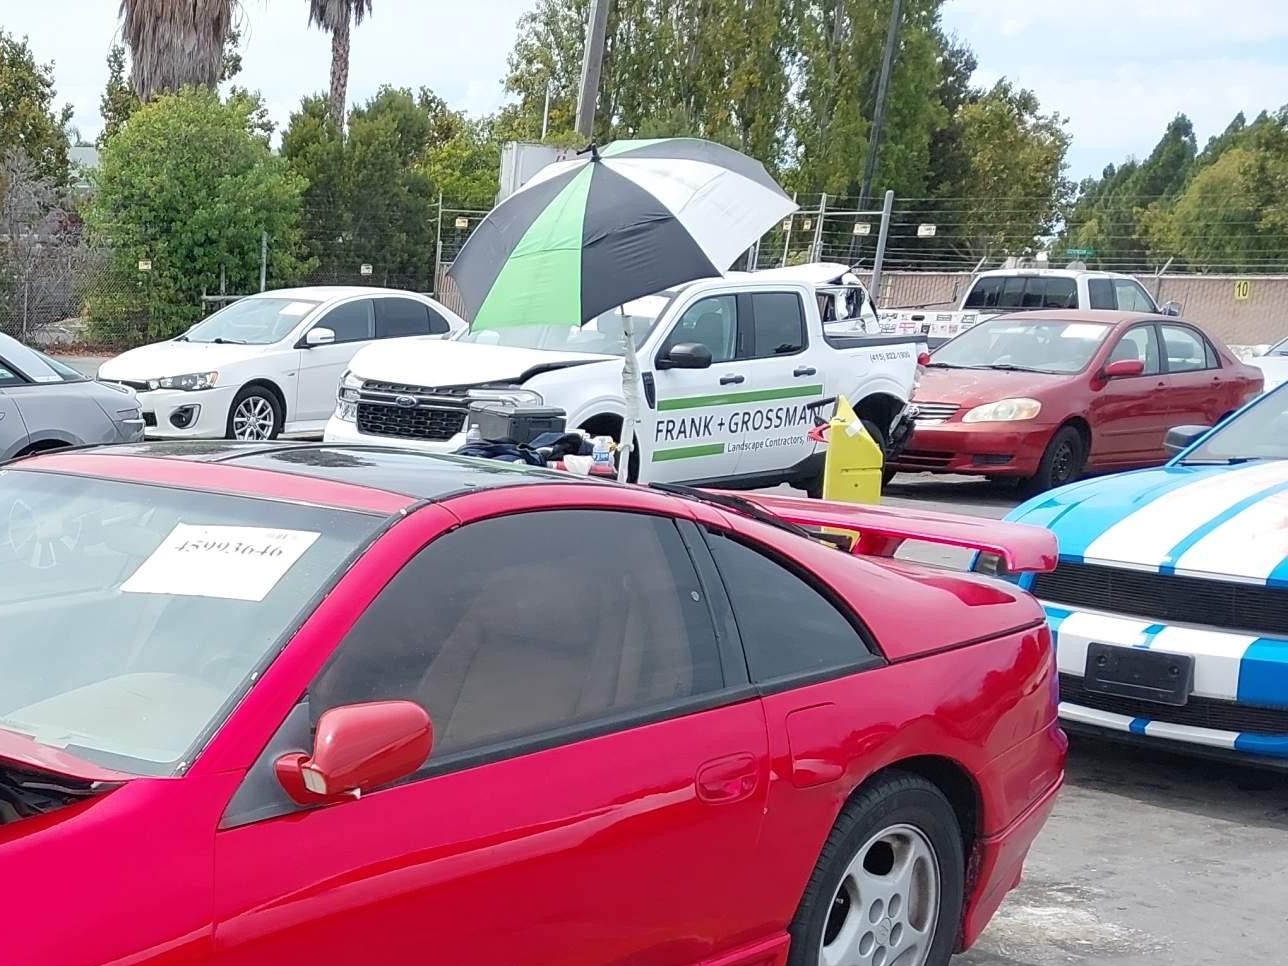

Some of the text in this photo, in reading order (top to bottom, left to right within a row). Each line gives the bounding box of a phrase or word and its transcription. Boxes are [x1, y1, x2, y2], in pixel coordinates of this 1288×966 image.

[1237, 281, 1248, 297] 10
[655, 405, 821, 442] FRANK + GROSSMAN
[727, 440, 764, 453] Landscape
[765, 436, 804, 448] Contractors,
